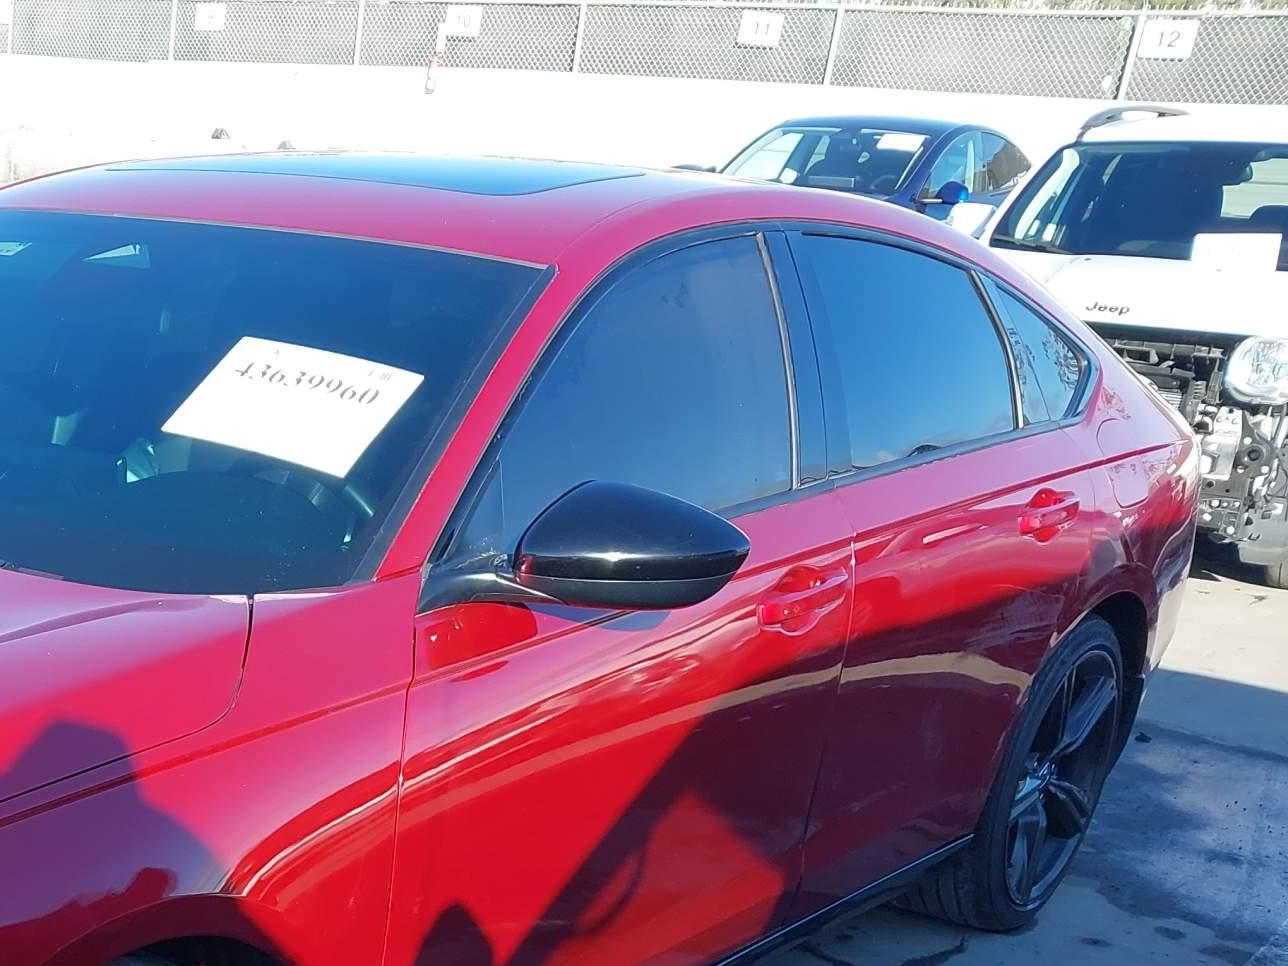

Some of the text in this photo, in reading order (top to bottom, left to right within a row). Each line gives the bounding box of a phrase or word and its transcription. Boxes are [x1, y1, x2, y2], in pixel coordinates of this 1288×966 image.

[1158, 30, 1181, 48] 12
[1085, 301, 1131, 317] Jeep
[234, 361, 381, 406] 43639960
